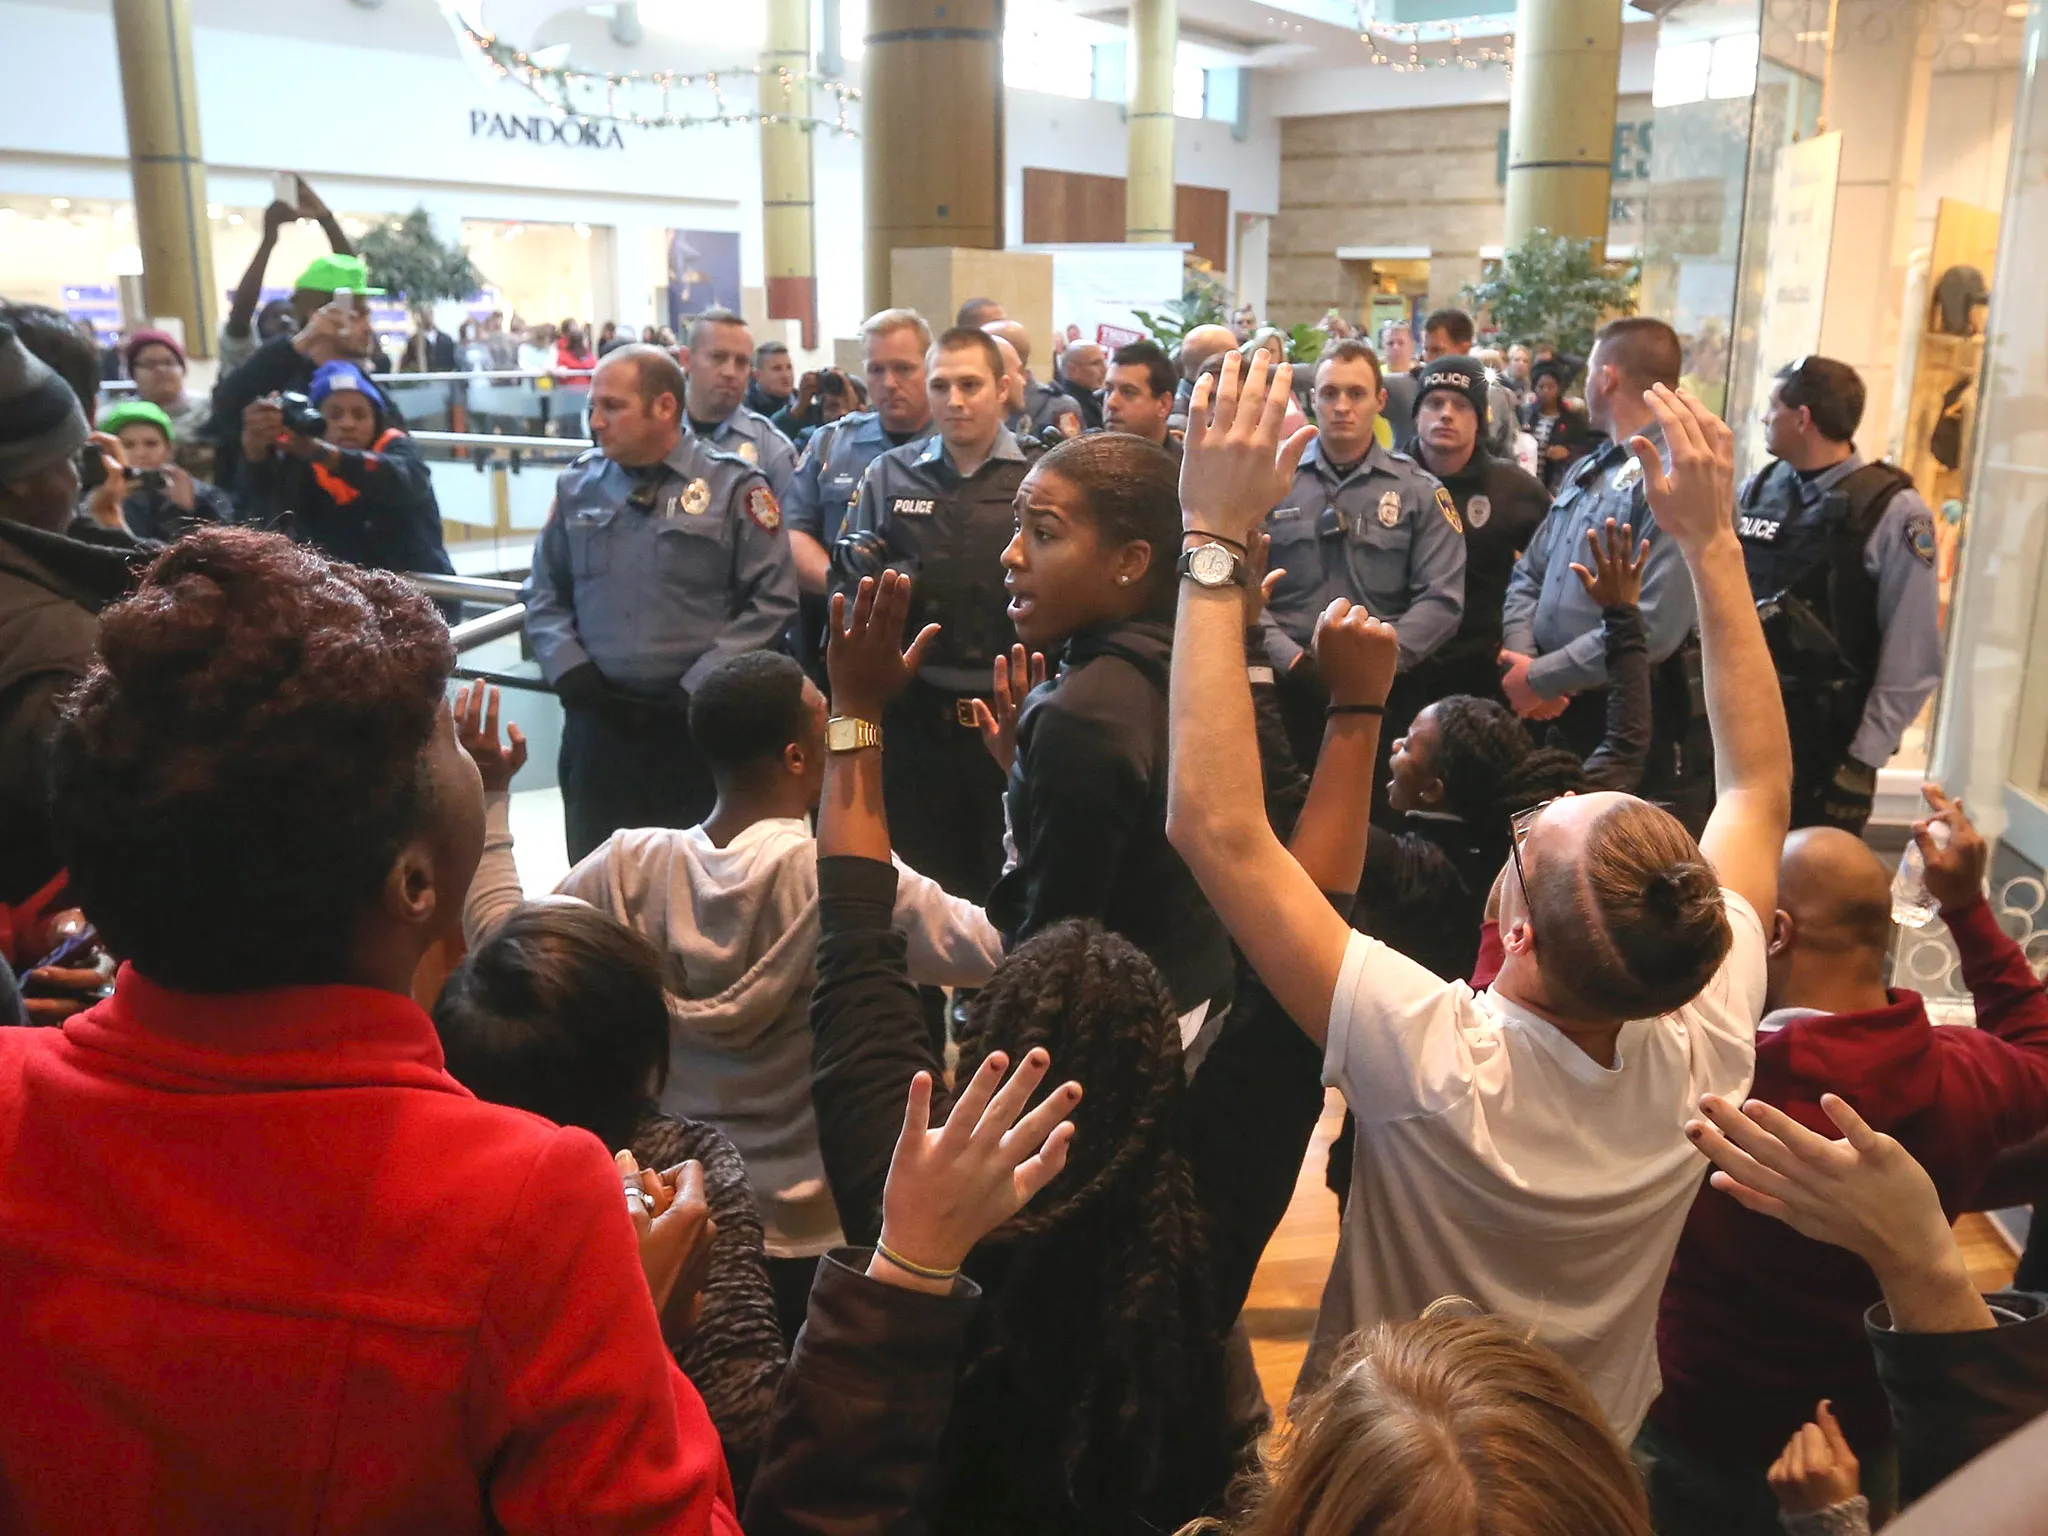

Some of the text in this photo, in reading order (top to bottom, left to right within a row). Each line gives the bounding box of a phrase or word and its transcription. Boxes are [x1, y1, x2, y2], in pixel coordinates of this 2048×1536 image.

[471, 109, 624, 150] PANDORA
[1424, 372, 1471, 388] POLICE
[893, 499, 935, 514] POLICE
